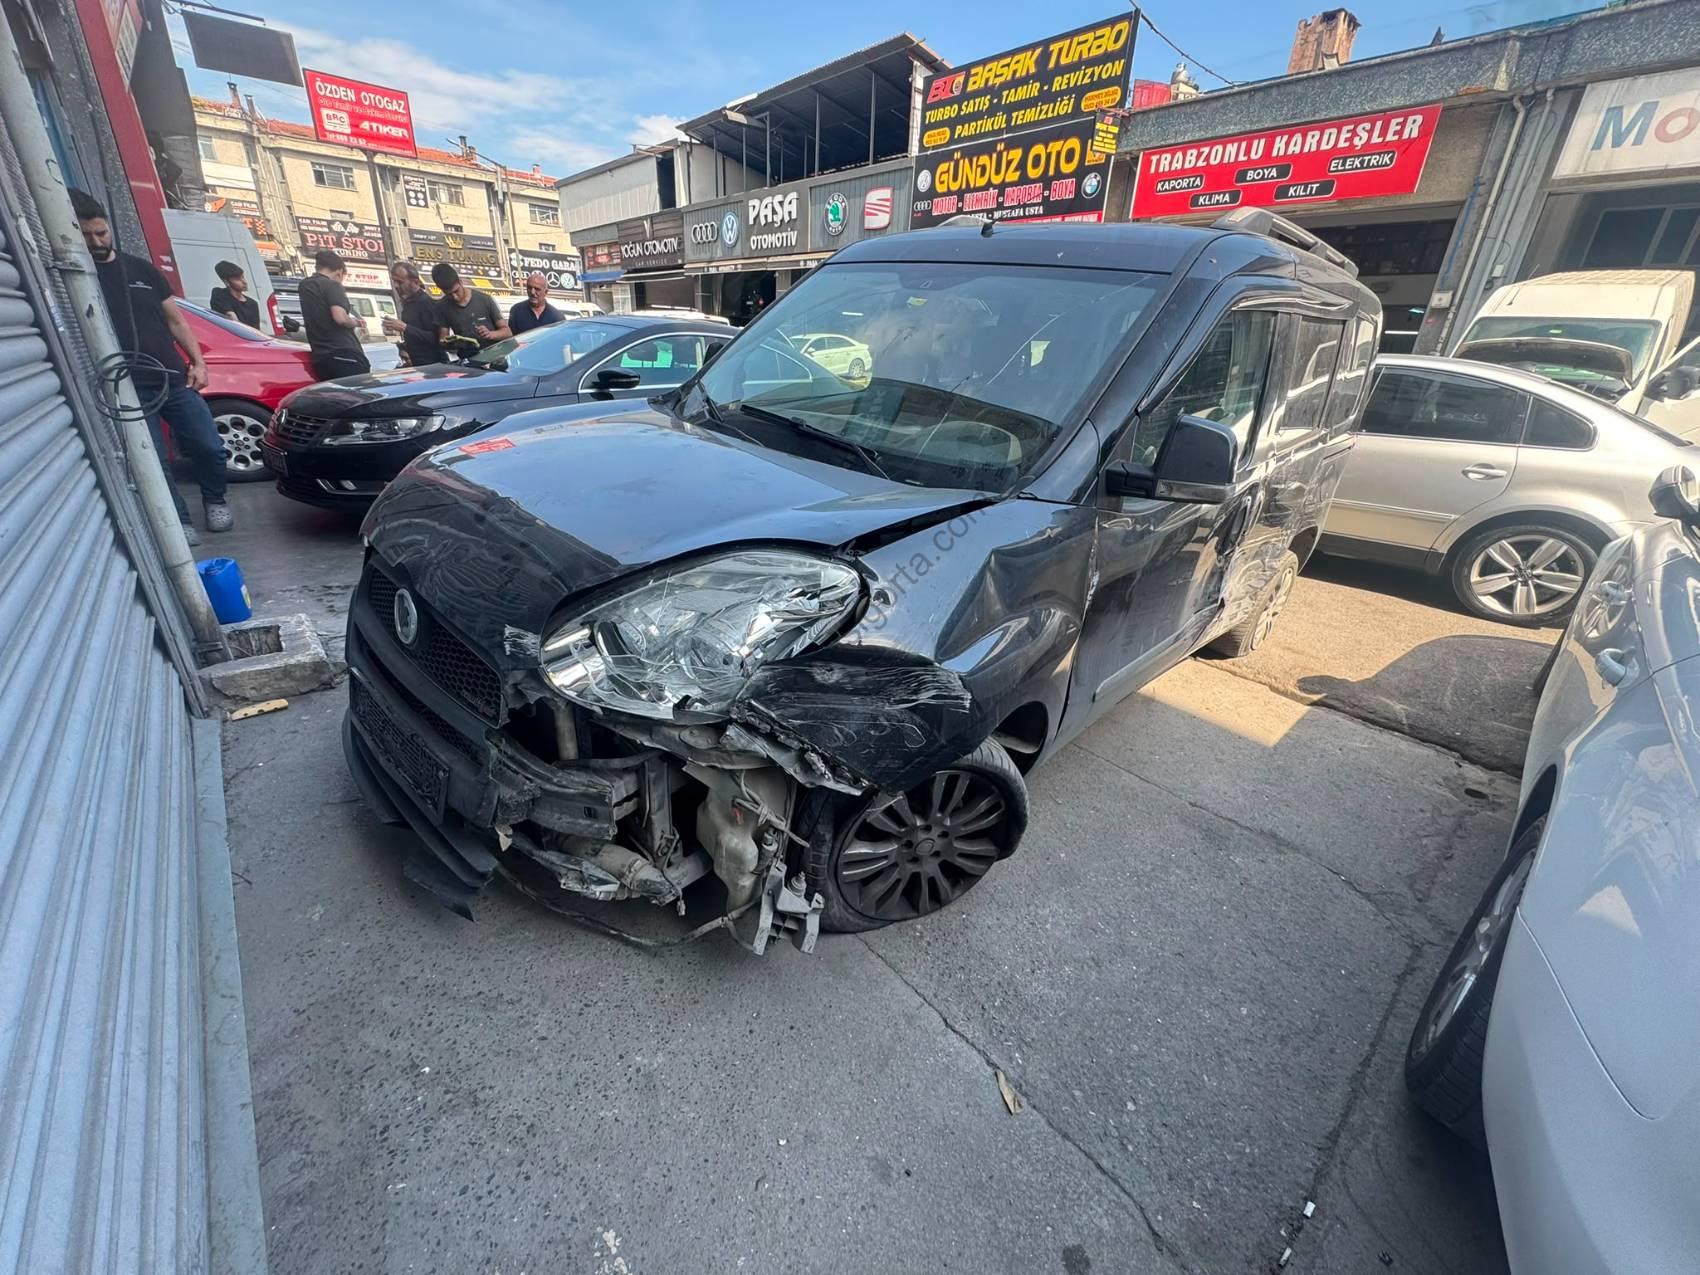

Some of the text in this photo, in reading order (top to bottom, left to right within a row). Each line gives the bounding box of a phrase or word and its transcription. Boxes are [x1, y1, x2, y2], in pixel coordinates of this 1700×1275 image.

[966, 20, 1130, 92] BAŞAK TURBO
[315, 77, 406, 114] ÖZDEN OTOGAZ
[925, 103, 958, 124] TURBO
[960, 94, 990, 116] SATIŞ
[1001, 79, 1040, 105] TAMİR
[1052, 59, 1125, 92] REVİZYON
[326, 113, 346, 124] BRC
[954, 114, 1007, 139] PARTİKÜL
[1011, 95, 1076, 126] TEMİZLİĞİ
[1149, 114, 1424, 174] TRABZONLU KARDEŞLER
[934, 137, 1081, 193] GÜNDÜZ OTO
[1246, 167, 1277, 181] BOYA
[931, 194, 958, 215] MOTOR
[1050, 178, 1076, 201] BOYA
[1156, 176, 1201, 192] KAPORTA
[748, 192, 800, 227] PAŞA
[1025, 206, 1044, 216] USTA
[621, 241, 644, 259] YOĞUN
[750, 228, 798, 250] OTOMOTİV
[417, 245, 497, 265] ENS TUNING
[523, 257, 550, 269] FEDO
